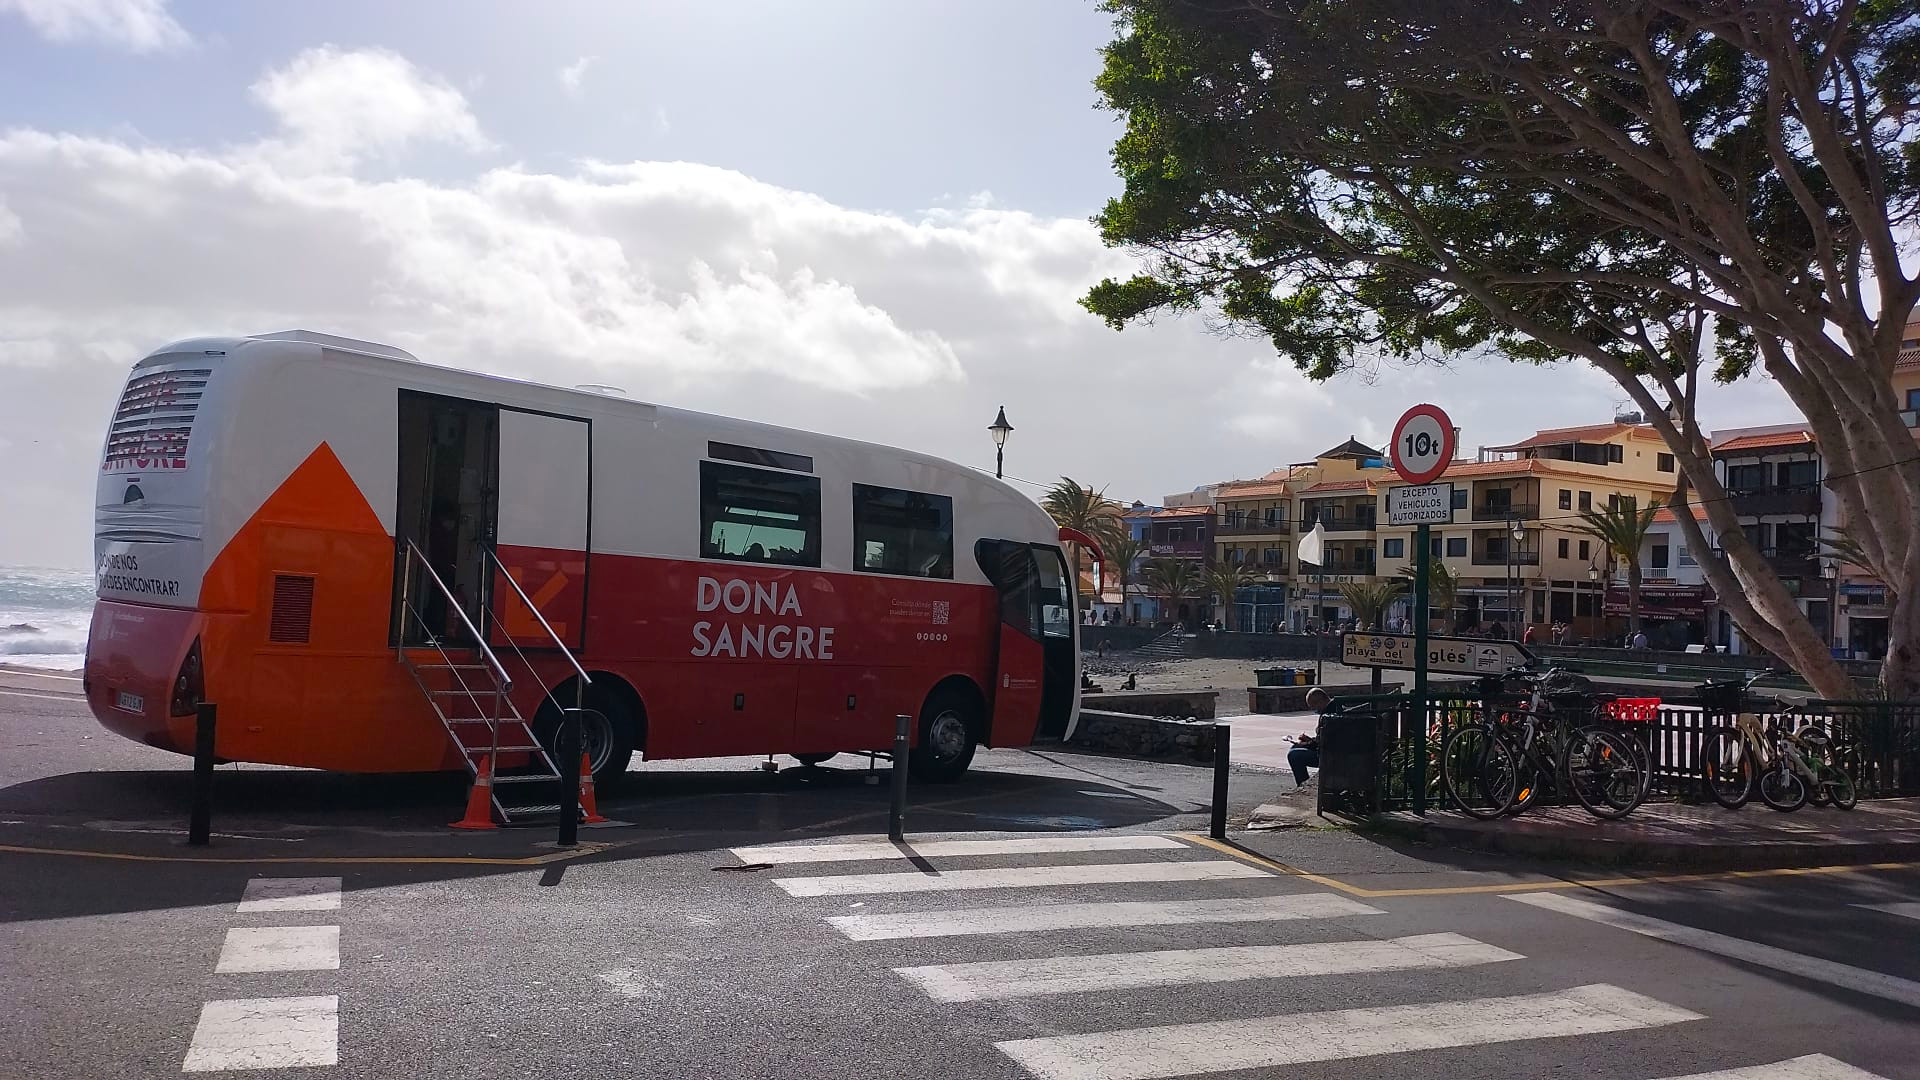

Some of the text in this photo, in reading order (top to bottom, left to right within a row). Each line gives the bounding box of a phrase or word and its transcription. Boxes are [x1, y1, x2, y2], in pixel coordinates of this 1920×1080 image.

[1402, 487, 1438, 498] EXCEPTO
[1392, 510, 1447, 521] AUTORIZADOS
[121, 555, 138, 571] NOS
[122, 576, 179, 597] ENCONTRAR?
[697, 576, 803, 617] DONA
[690, 621, 835, 660] SANGRE
[1346, 646, 1376, 658] playa
[1429, 648, 1467, 664] glés
